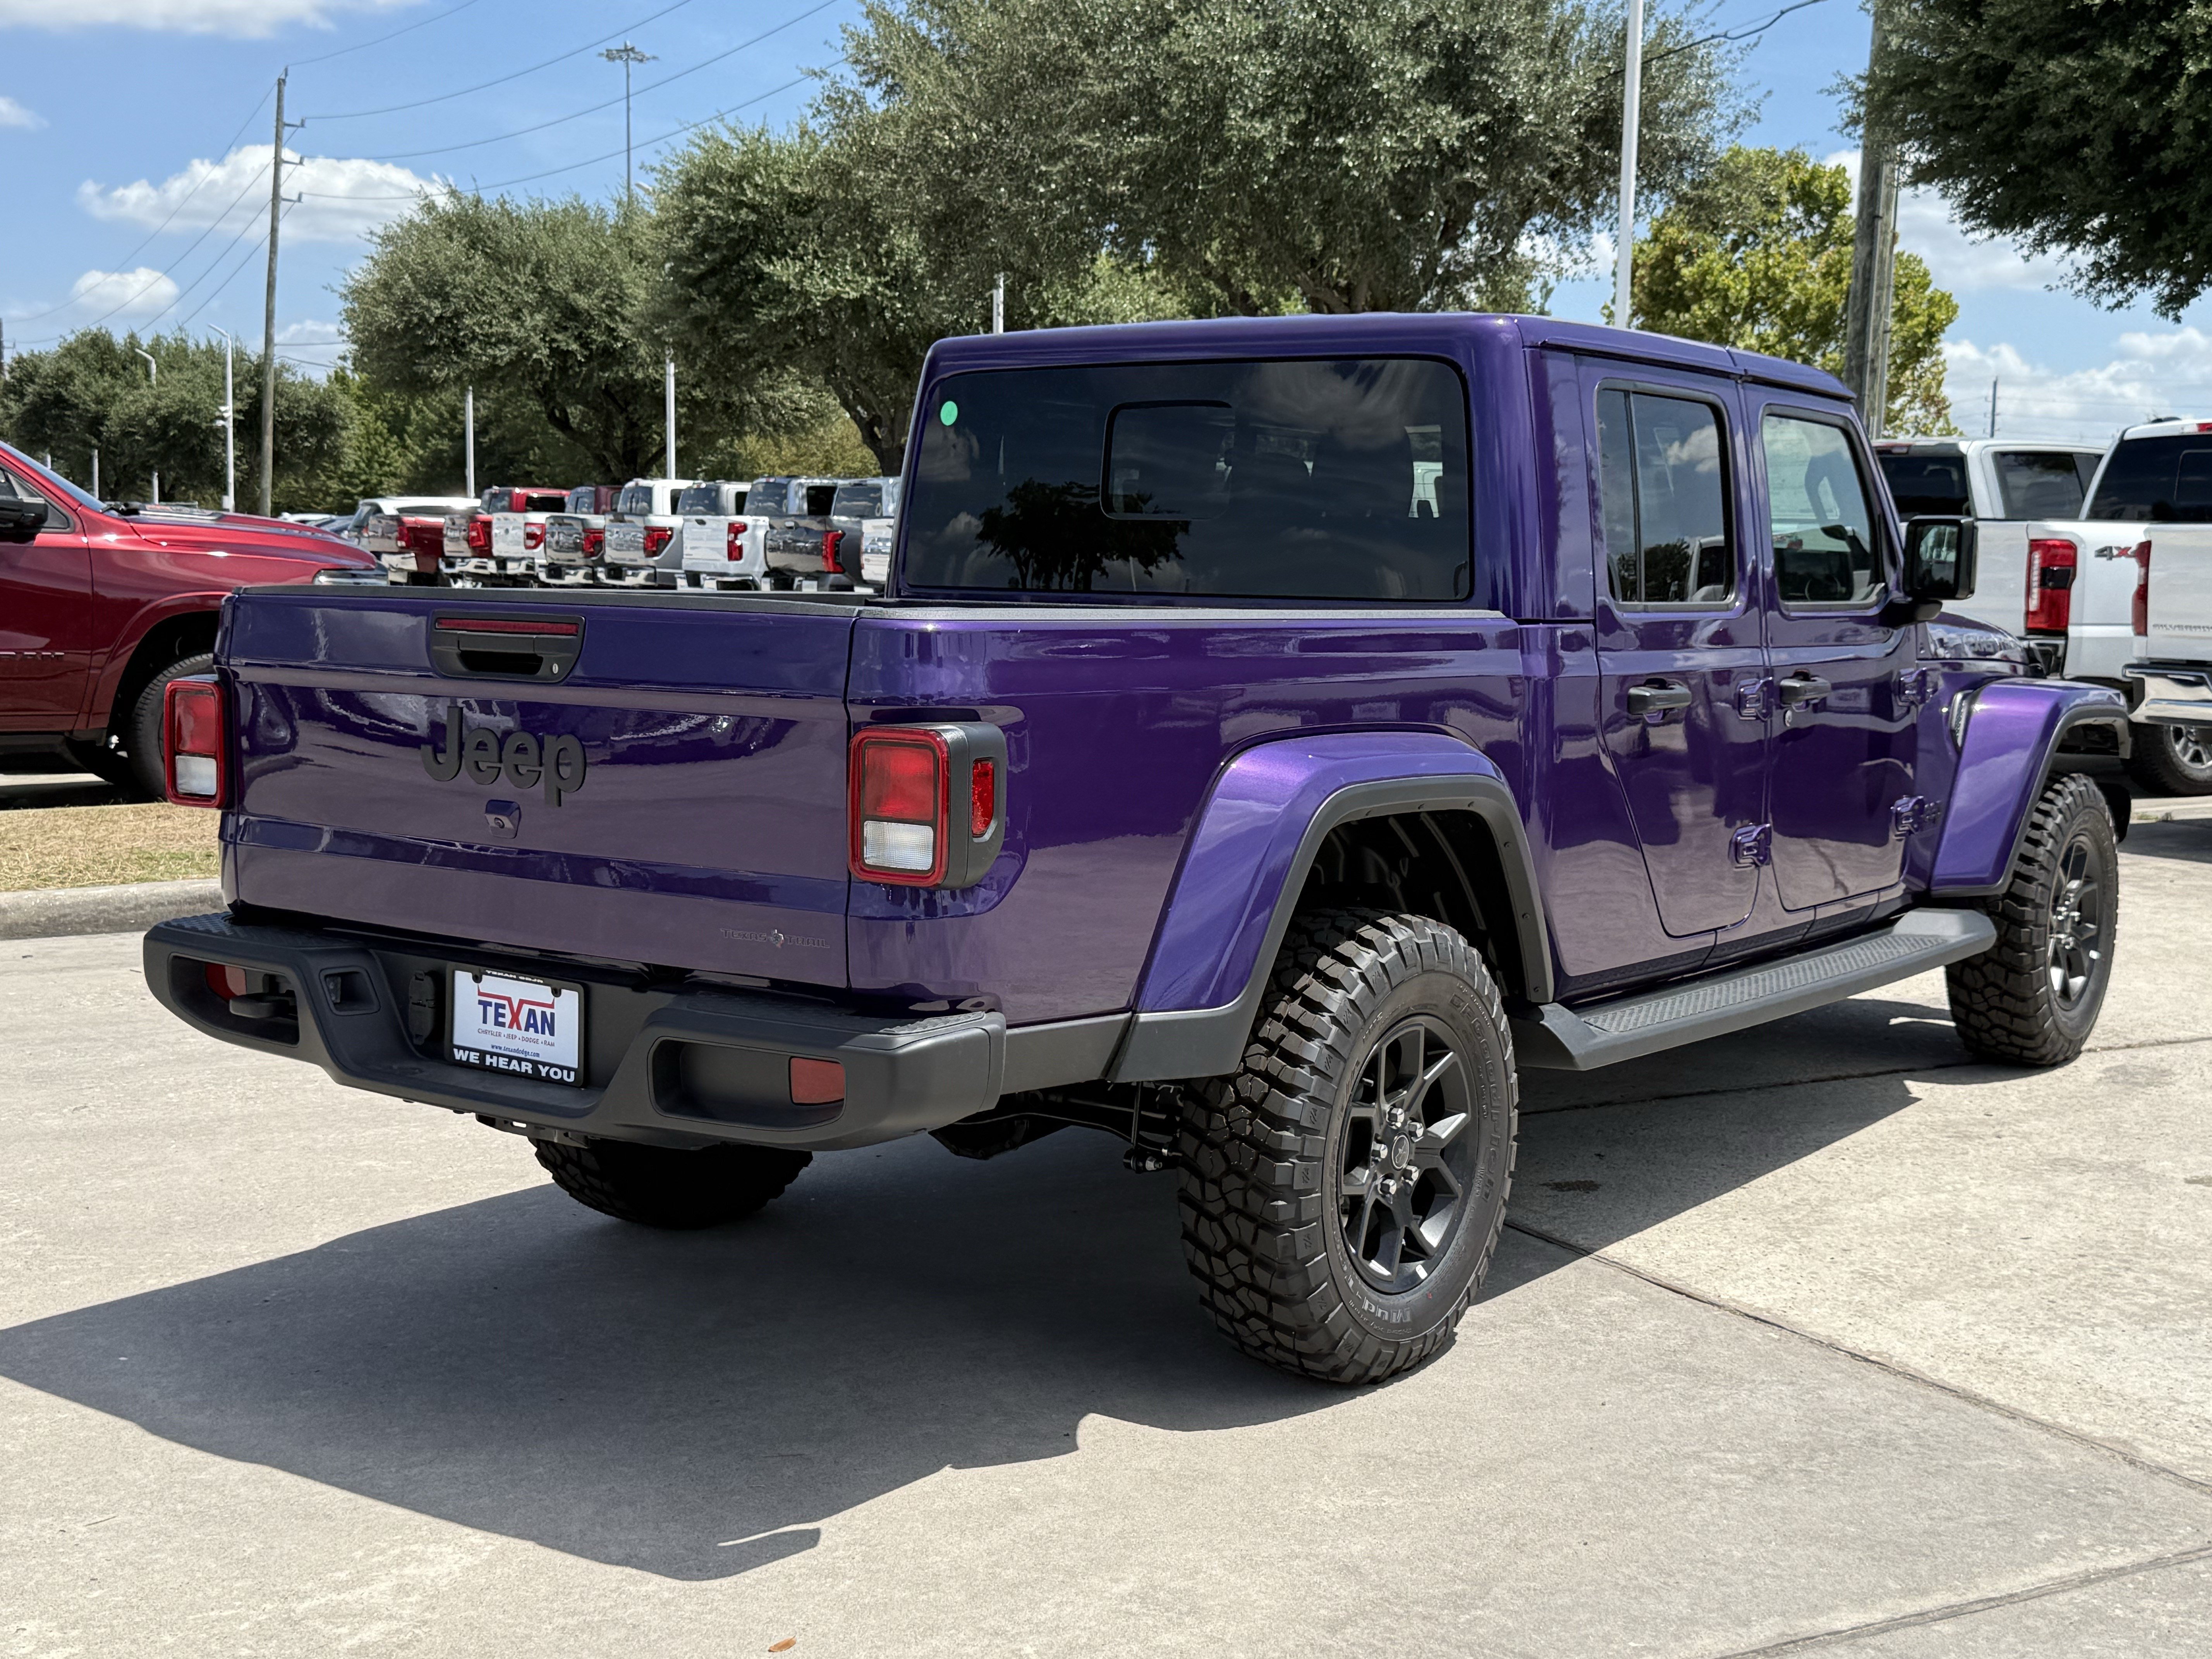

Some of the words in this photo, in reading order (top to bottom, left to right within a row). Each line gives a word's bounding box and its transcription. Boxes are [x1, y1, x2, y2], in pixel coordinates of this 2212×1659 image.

[421, 706, 587, 807] Jeep
[477, 987, 555, 1037] TEXAN
[477, 1028, 502, 1038] CHRYSLER
[506, 1032, 517, 1040] JEEP
[522, 1036, 540, 1045] DODGE
[453, 1048, 480, 1063] WE
[485, 1054, 532, 1074] HEAR
[538, 1064, 575, 1082] YOU
